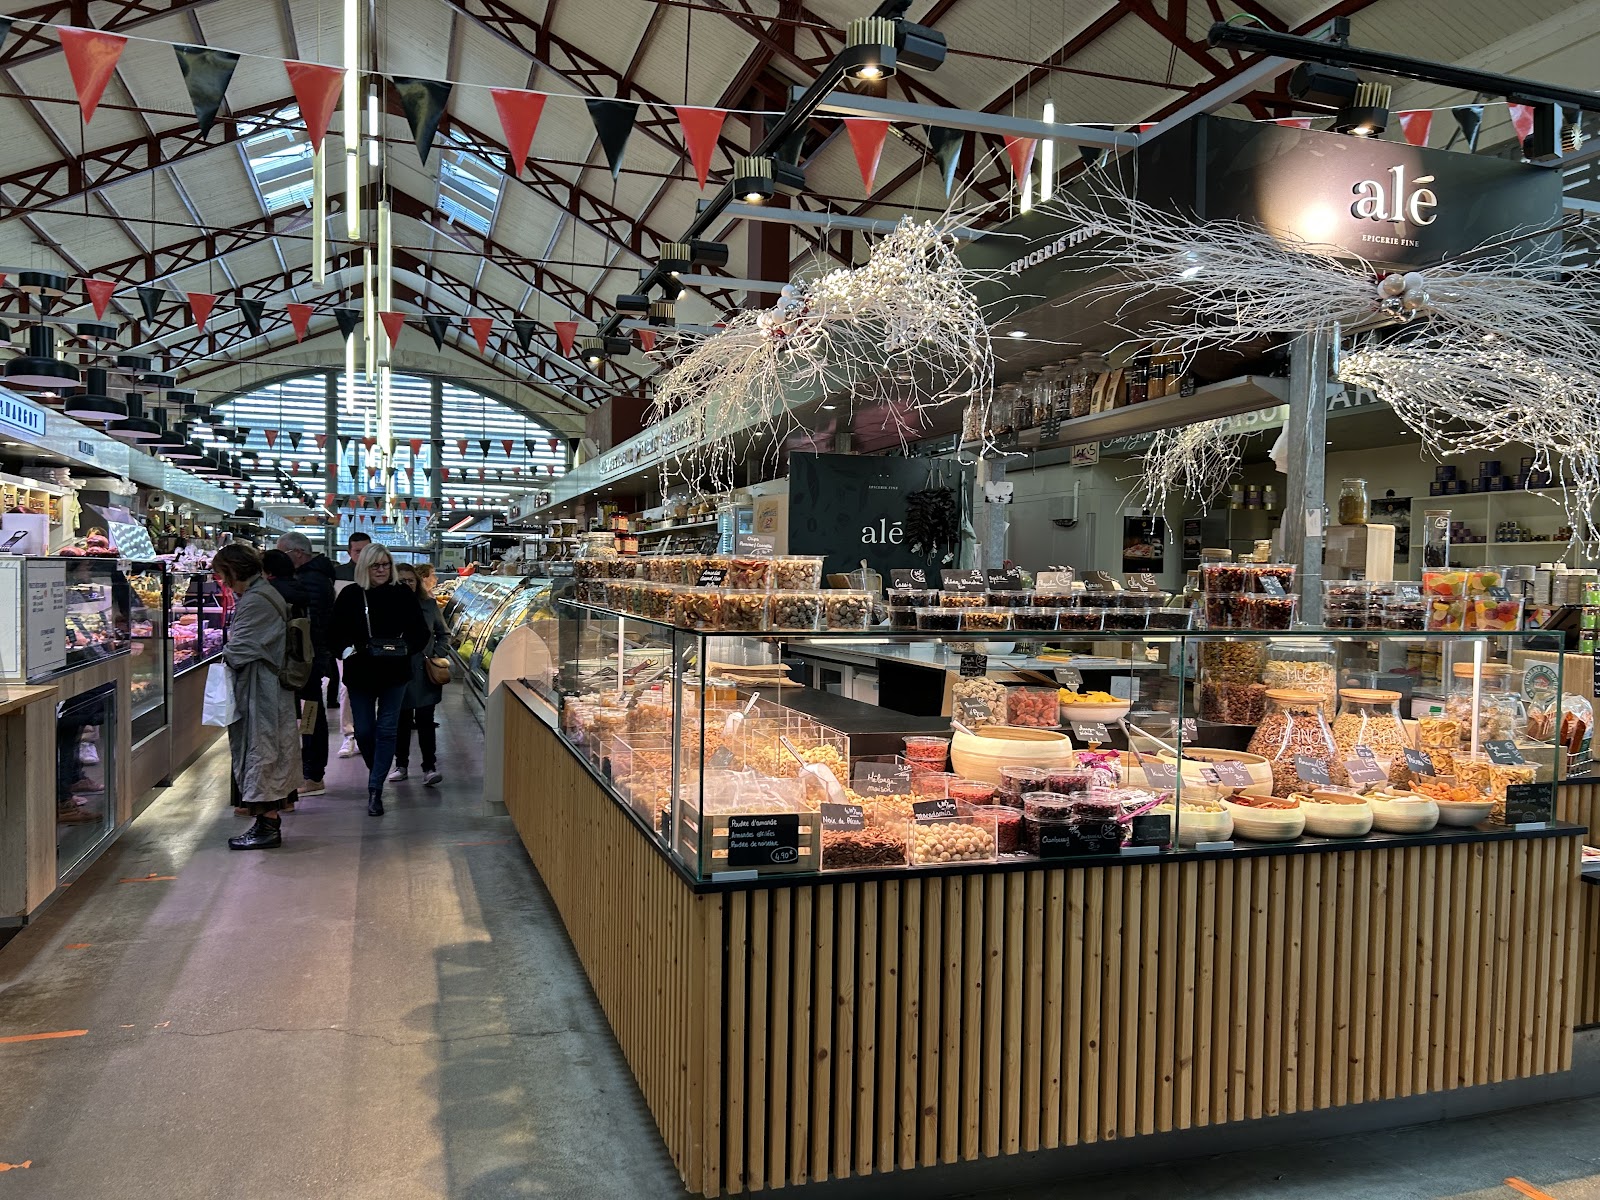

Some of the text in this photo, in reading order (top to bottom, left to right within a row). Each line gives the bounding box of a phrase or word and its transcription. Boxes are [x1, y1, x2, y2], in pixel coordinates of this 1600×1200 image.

[1351, 165, 1438, 227] alé
[1362, 234, 1420, 247] EPICERIE FINE
[1010, 238, 1066, 275] EPICERIE
[5, 401, 38, 429] MARGOT
[861, 517, 904, 544] alé
[1286, 668, 1331, 681] MUESLI
[1265, 726, 1328, 745] GRANOL
[866, 786, 894, 794] maison
[731, 818, 778, 828] Poudre d'amande
[731, 831, 755, 839] Amandes
[749, 840, 757, 848] de
